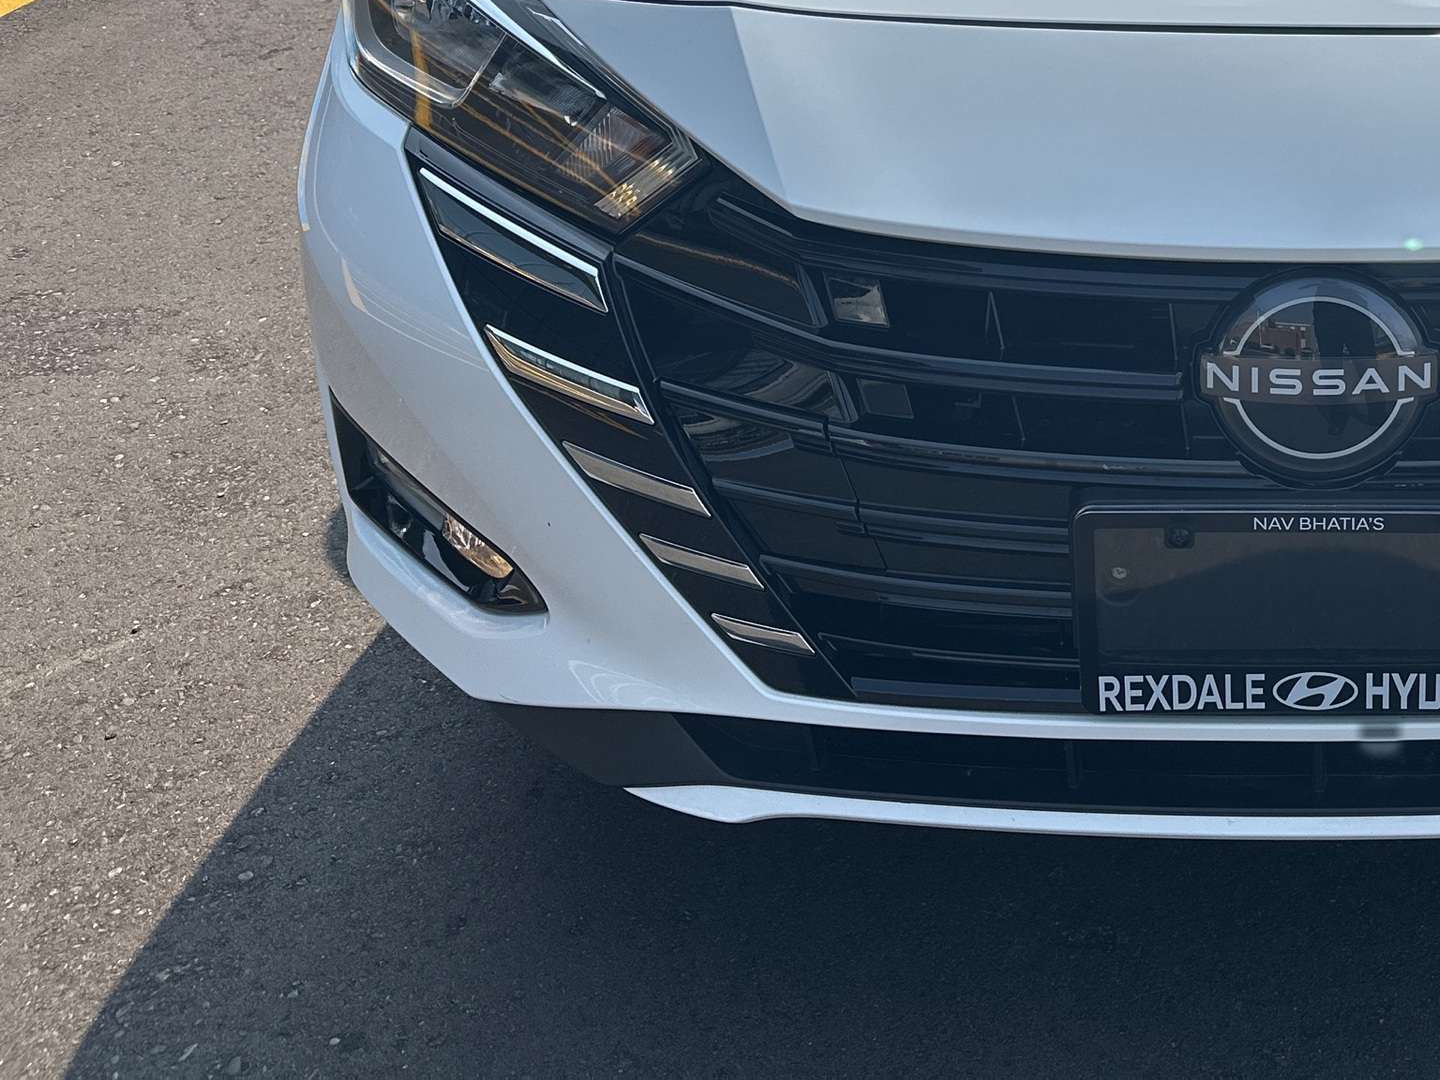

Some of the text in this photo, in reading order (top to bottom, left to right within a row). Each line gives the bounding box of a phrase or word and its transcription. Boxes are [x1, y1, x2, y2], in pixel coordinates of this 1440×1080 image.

[1205, 361, 1432, 397] NISSAN
[1253, 516, 1386, 531] NAV BHATIA'S
[1098, 673, 1266, 713] REXDALE
